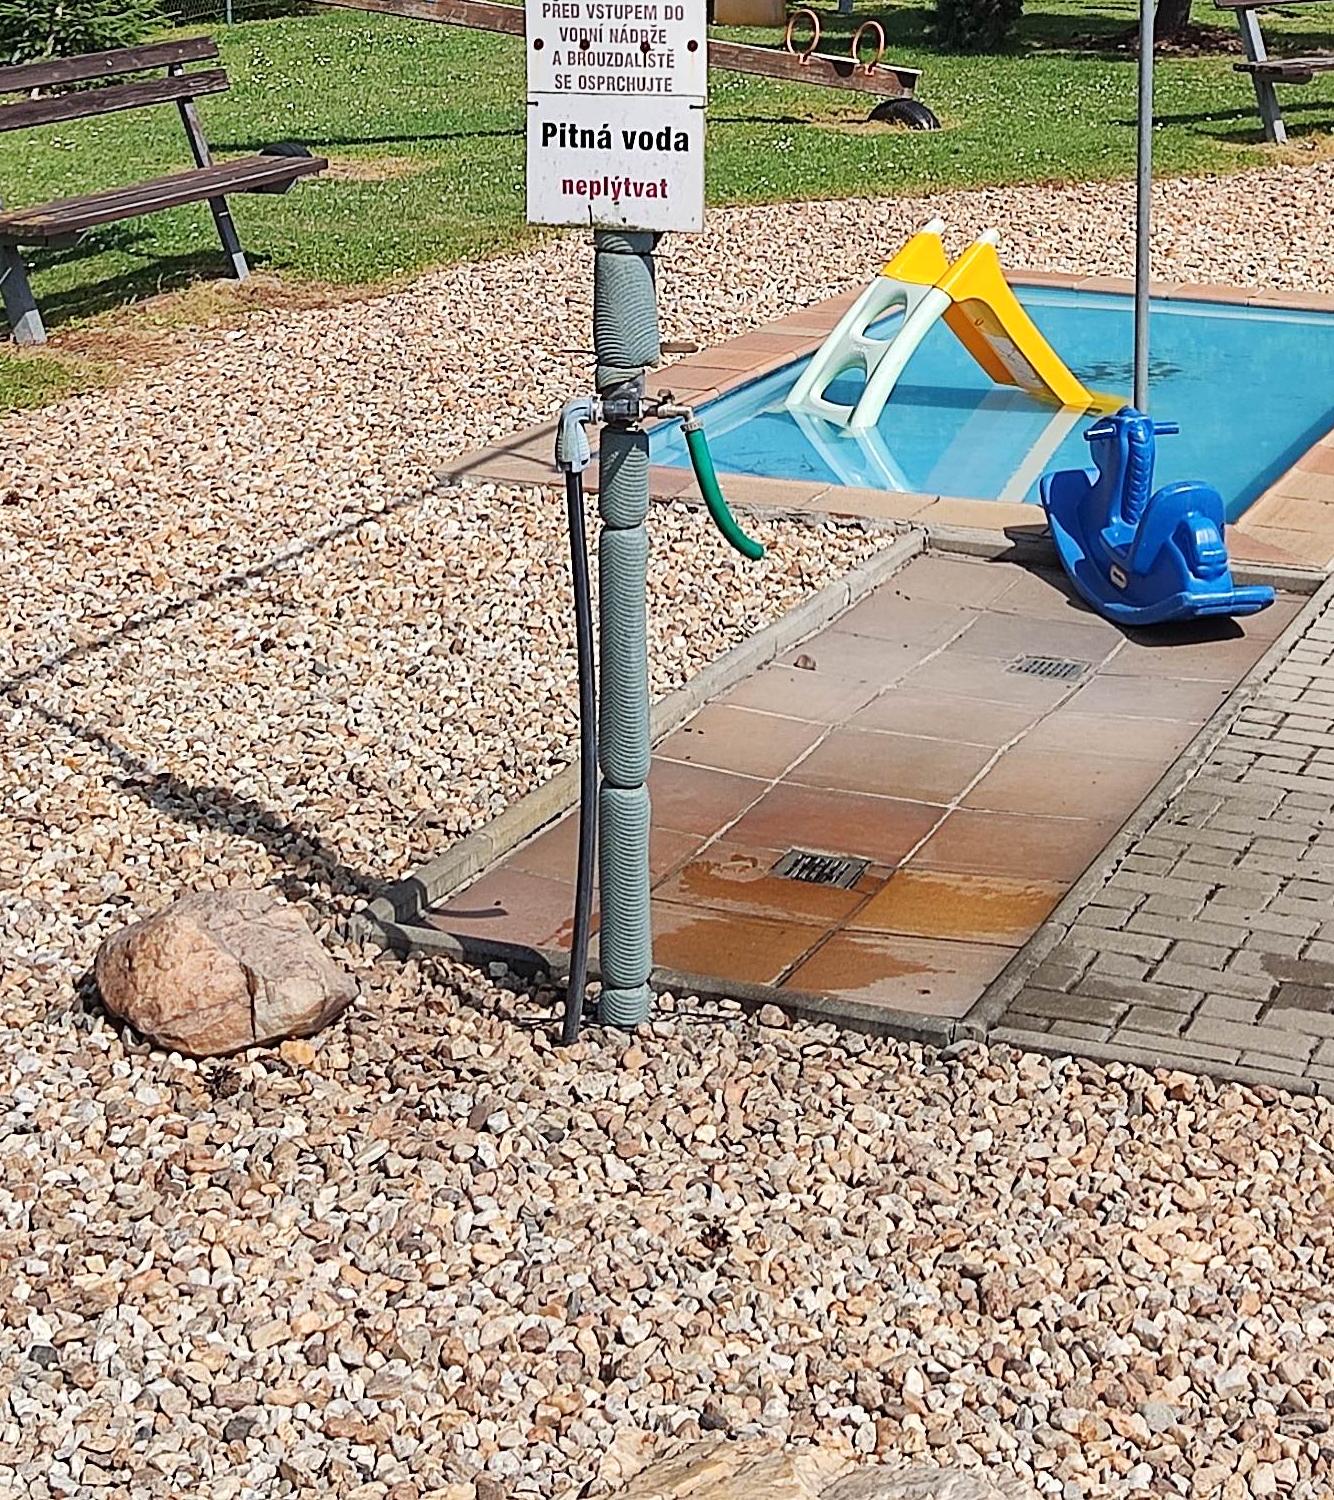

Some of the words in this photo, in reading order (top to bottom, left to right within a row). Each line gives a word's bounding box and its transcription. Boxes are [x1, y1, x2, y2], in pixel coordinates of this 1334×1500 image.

[586, 3, 657, 21] VSTUPEM
[664, 5, 684, 21] DO
[559, 23, 603, 44] VODNÍ
[609, 24, 667, 45] NÁDRŽE
[552, 50, 562, 66] A
[567, 48, 675, 69] BROUZDALIŠTĚ
[554, 74, 572, 90] SE
[578, 75, 673, 93] OSPRCHUJTE
[542, 122, 612, 150] Pitná
[621, 126, 689, 152] voda
[562, 176, 668, 201] neplýtvat
